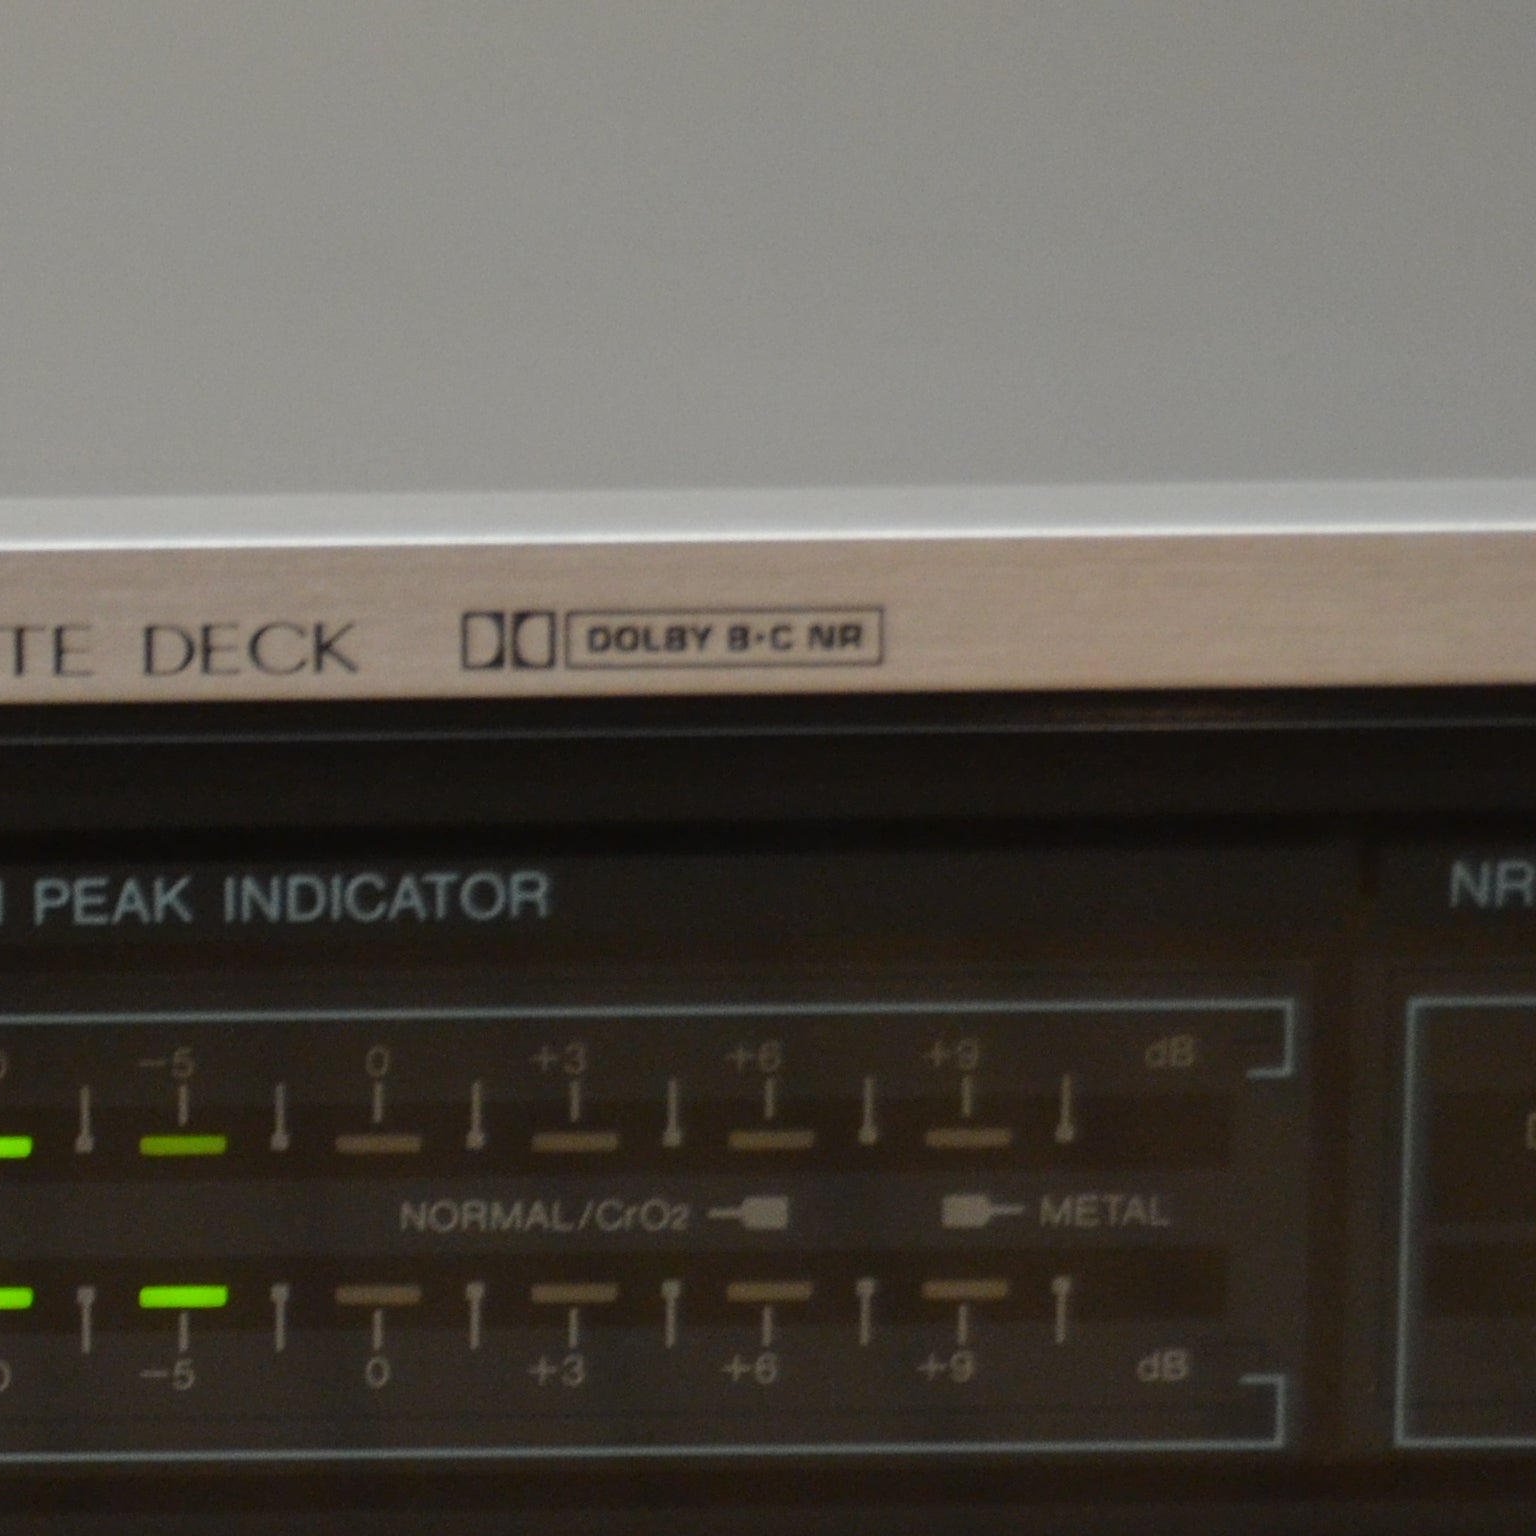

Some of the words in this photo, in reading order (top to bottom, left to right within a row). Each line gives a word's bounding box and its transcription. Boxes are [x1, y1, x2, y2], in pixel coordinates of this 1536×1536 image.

[142, 618, 360, 676] DECK
[587, 624, 711, 653] DOLBY
[807, 622, 864, 649] NR
[33, 876, 194, 925] PEAK
[223, 868, 552, 924] INDICATOR
[364, 1044, 391, 1078] 0
[530, 1042, 588, 1075] +3
[726, 1040, 783, 1072] +6
[1144, 1034, 1196, 1069] dB
[1039, 1194, 1172, 1228] METAL
[364, 1356, 391, 1388] 0
[530, 1354, 586, 1386] +3
[722, 1352, 778, 1384] +6
[917, 1350, 975, 1382] +9
[1136, 1347, 1191, 1382] dB
